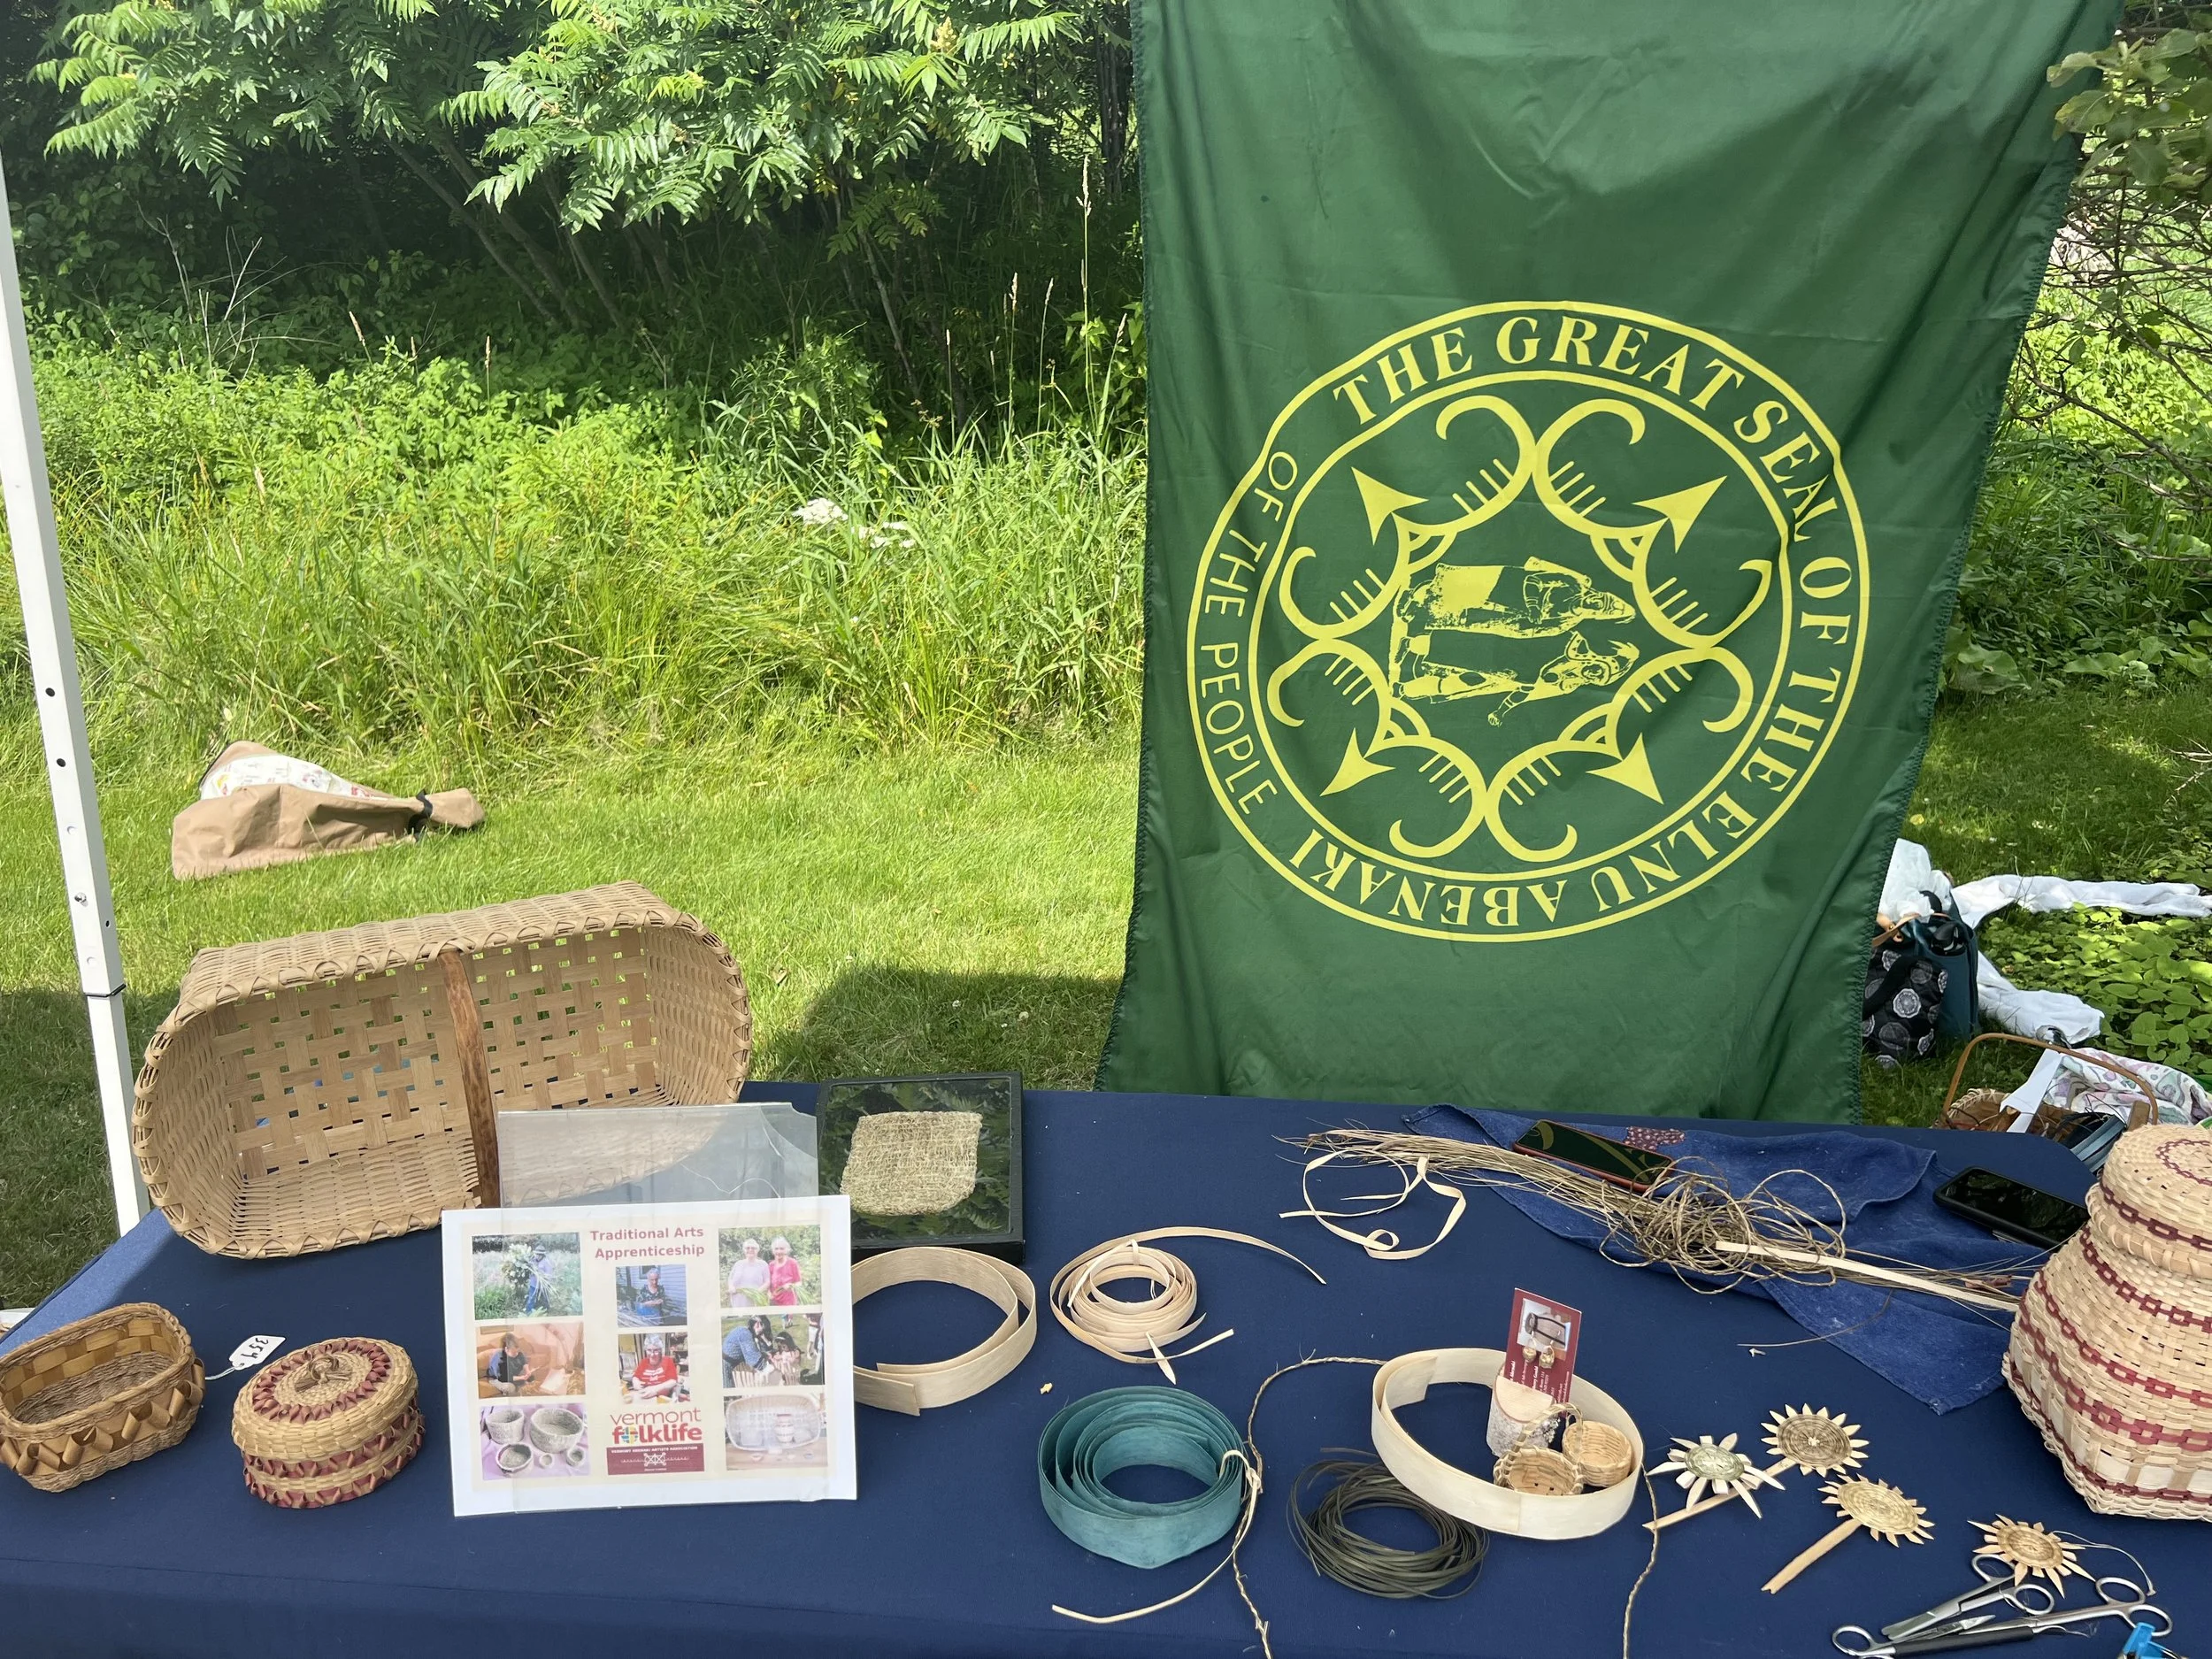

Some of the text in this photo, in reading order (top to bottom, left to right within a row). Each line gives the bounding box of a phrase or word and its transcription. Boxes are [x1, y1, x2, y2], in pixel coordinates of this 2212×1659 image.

[1288, 316, 1852, 926] THE GREAT SEAL OF THE ELNU ABENAKI
[1201, 451, 1298, 815] OF THE PEOPLE
[590, 1226, 704, 1240] Traditional Arts
[595, 1244, 705, 1261] Apprenticeship
[610, 1407, 702, 1425] vermont
[612, 1423, 703, 1444] folklife
